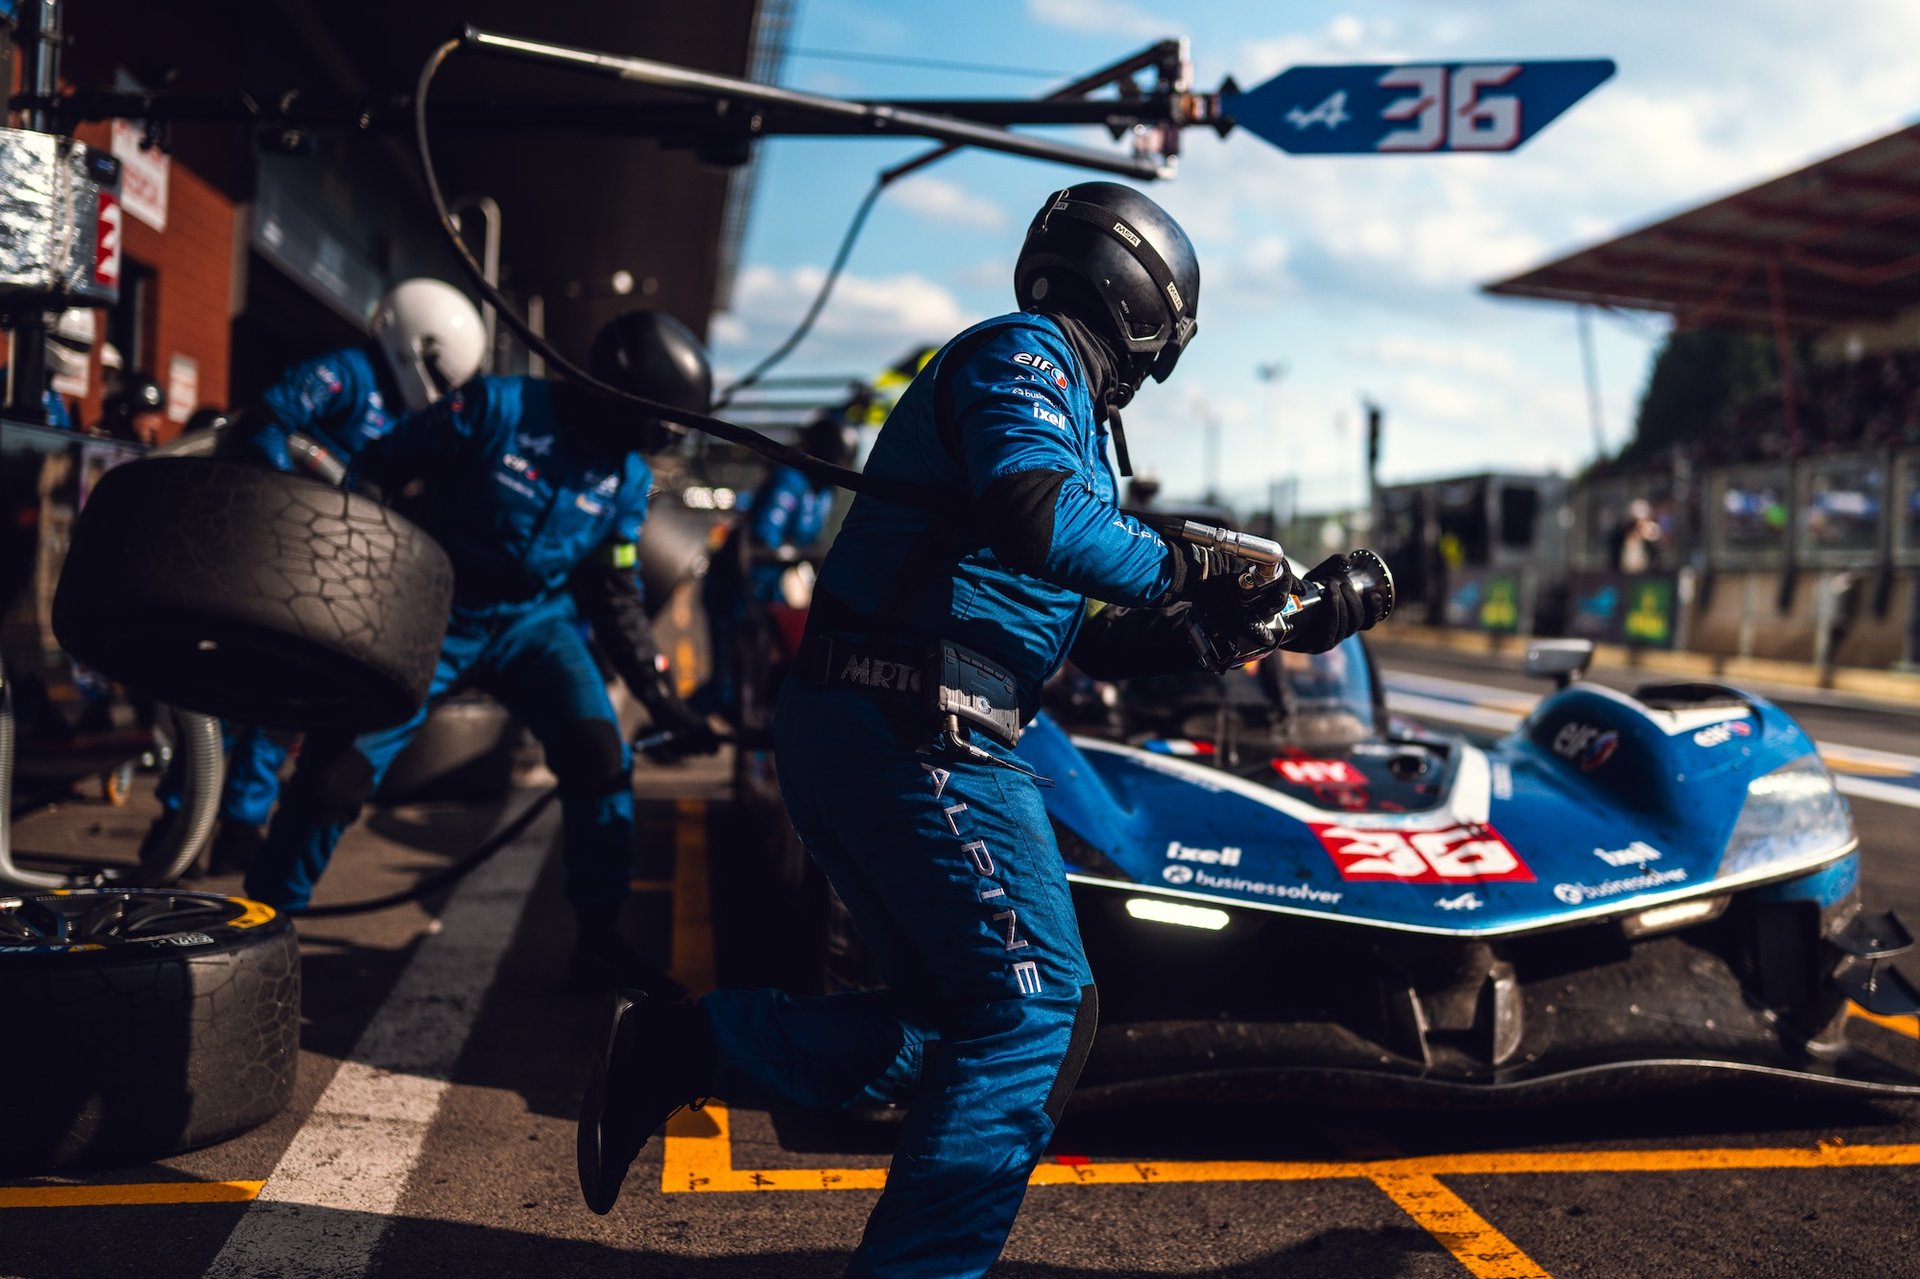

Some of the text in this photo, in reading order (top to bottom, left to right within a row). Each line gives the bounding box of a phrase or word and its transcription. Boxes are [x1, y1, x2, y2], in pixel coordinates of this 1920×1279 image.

[1375, 65, 1522, 152] 36
[1113, 223, 1140, 247] MSA
[1167, 282, 1183, 311] MSA
[1012, 352, 1055, 372] elf
[1032, 401, 1066, 431] ixell
[1321, 825, 1520, 878] 36
[920, 761, 1042, 995] ALPINE
[1195, 869, 1343, 904] businessolver
[1574, 868, 1688, 900] businessolver
